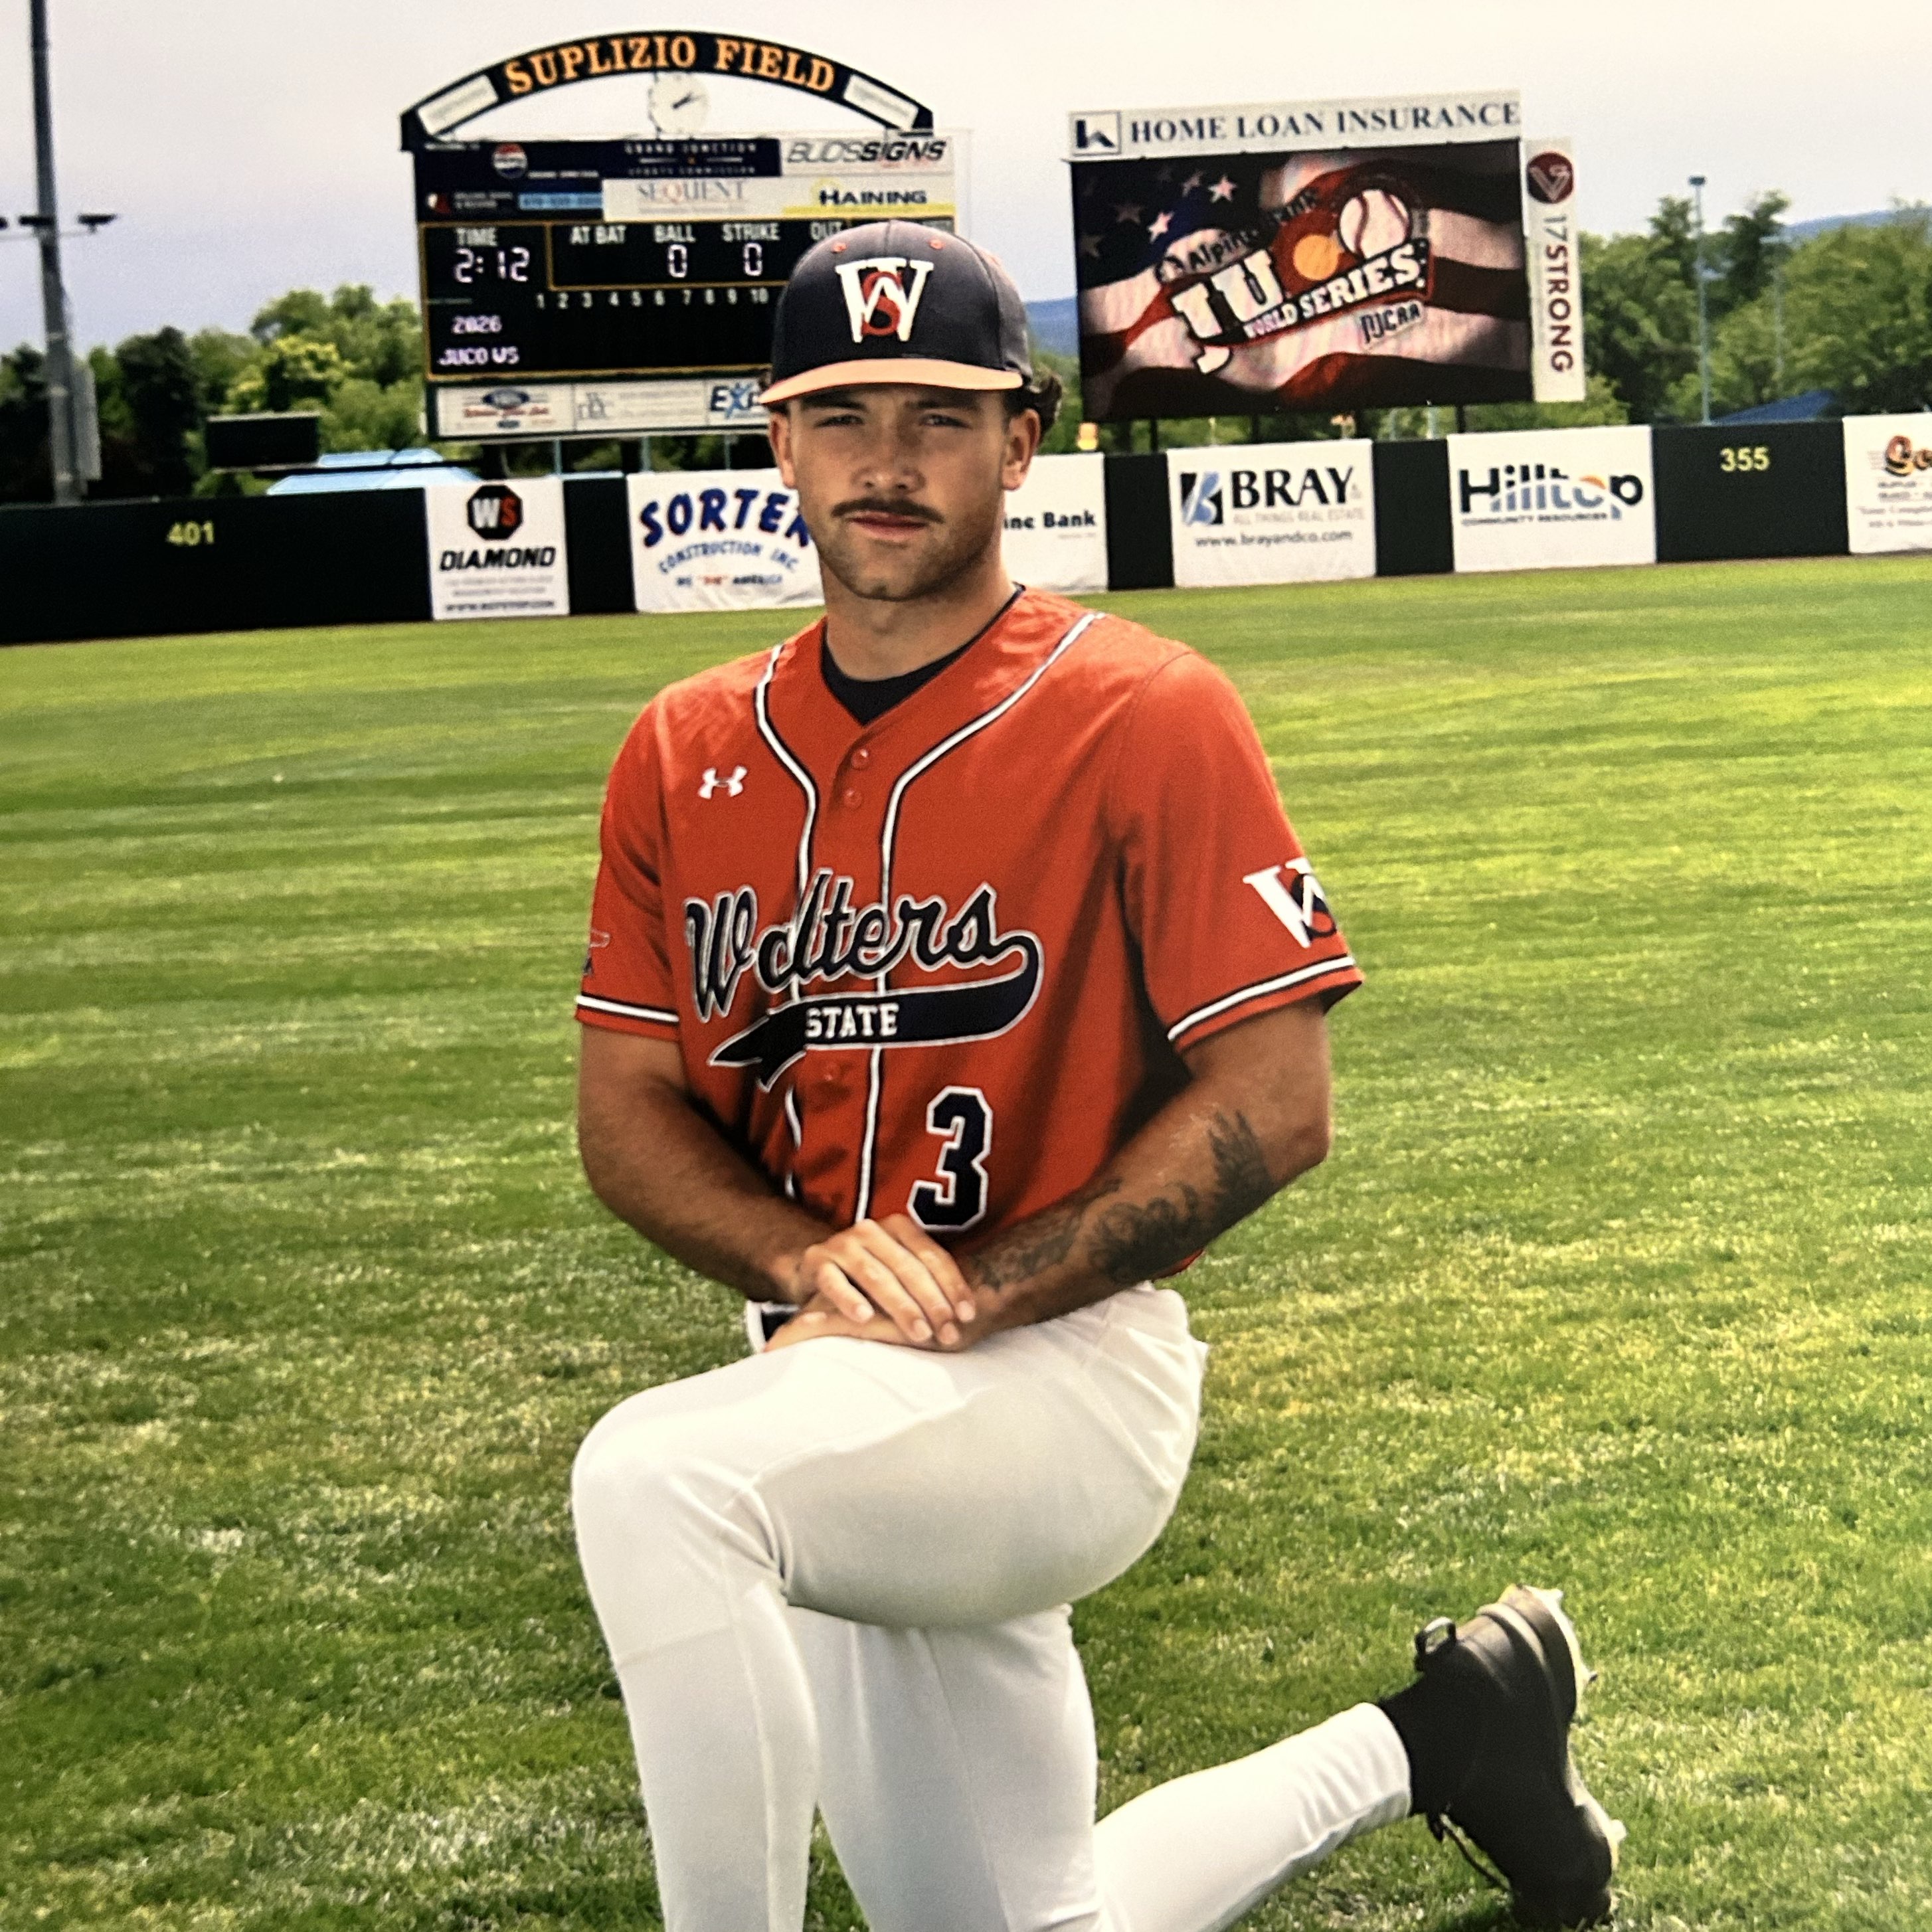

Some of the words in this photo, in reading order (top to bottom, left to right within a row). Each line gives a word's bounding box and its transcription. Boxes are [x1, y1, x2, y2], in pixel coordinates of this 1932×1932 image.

[504, 35, 696, 95] SUPLIZIO
[715, 37, 835, 92] FIELD
[1130, 116, 1227, 142] HOME
[1237, 111, 1323, 138] LOAN
[1337, 102, 1520, 132] INSURANCE
[819, 189, 928, 206] HAINING
[456, 226, 497, 247] TIME
[569, 225, 590, 245] AT
[595, 224, 626, 245] BAT
[654, 223, 696, 244] BALL
[723, 222, 781, 242] STRIKE
[454, 246, 531, 284] 2:12
[667, 243, 688, 278] 0
[742, 242, 763, 277] 0
[536, 292, 545, 309] 1
[558, 292, 569, 309] 2
[581, 291, 593, 309] 3
[608, 290, 620, 307] 4
[631, 290, 643, 307] 5
[654, 290, 665, 307] 6
[683, 288, 692, 306] 7
[704, 288, 715, 306] 8
[727, 287, 738, 306] 9
[750, 287, 769, 305] 10
[437, 346, 489, 366] JUCO
[1719, 446, 1771, 472] 355
[1230, 464, 1354, 509] BRAY
[1458, 463, 1644, 521] Hilltop
[472, 495, 518, 529] WS
[1043, 509, 1096, 528] Bank
[165, 520, 215, 546] 401
[440, 546, 557, 572] DIAMOND
[658, 540, 762, 574] CONSTRUCTION
[684, 867, 999, 1023] Walters
[805, 1002, 900, 1039] STATE
[906, 1085, 994, 1232] 3
